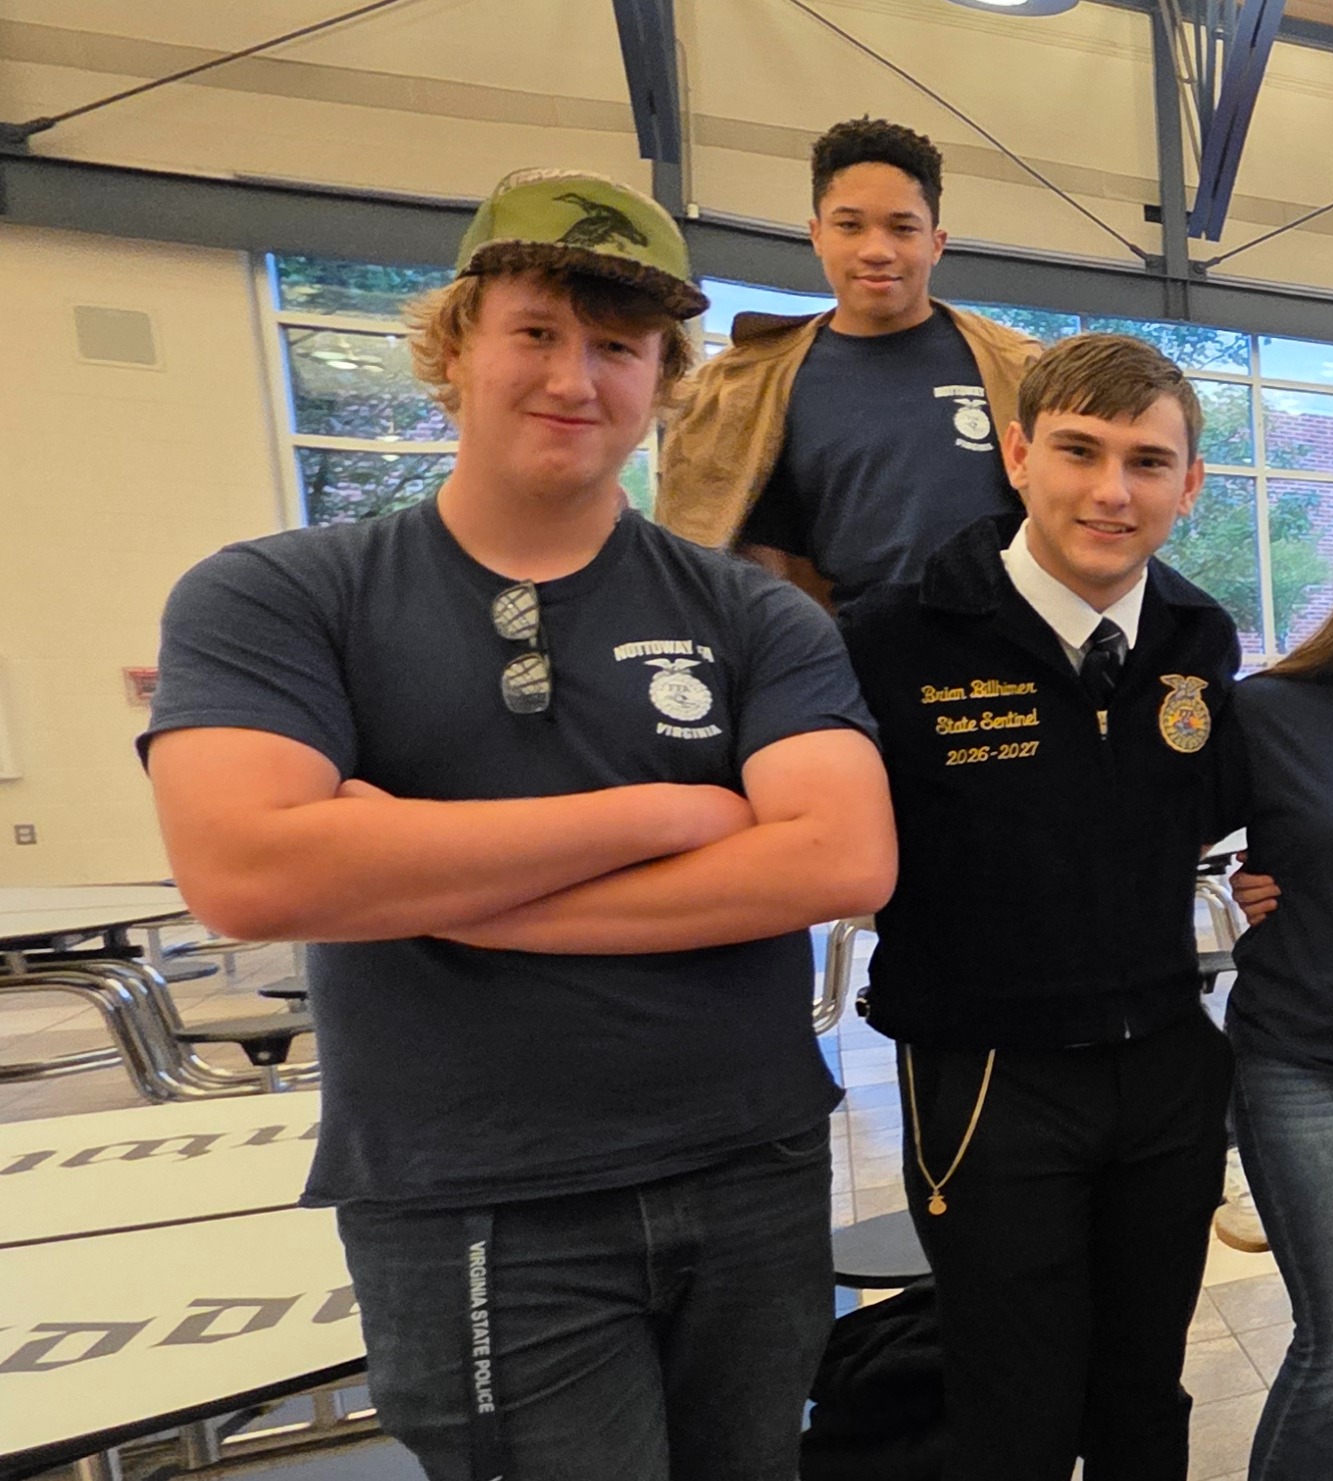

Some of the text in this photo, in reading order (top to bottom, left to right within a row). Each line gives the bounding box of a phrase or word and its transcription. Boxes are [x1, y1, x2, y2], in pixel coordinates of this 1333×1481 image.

[613, 639, 693, 662] NOTTOWAY
[921, 685, 967, 704] Brian
[656, 722, 722, 739] VIRGINIA
[936, 707, 1040, 735] State Sentinel
[945, 741, 1040, 766] 2026-2027
[468, 1241, 495, 1415] VIRGINIA STATE POLICE
